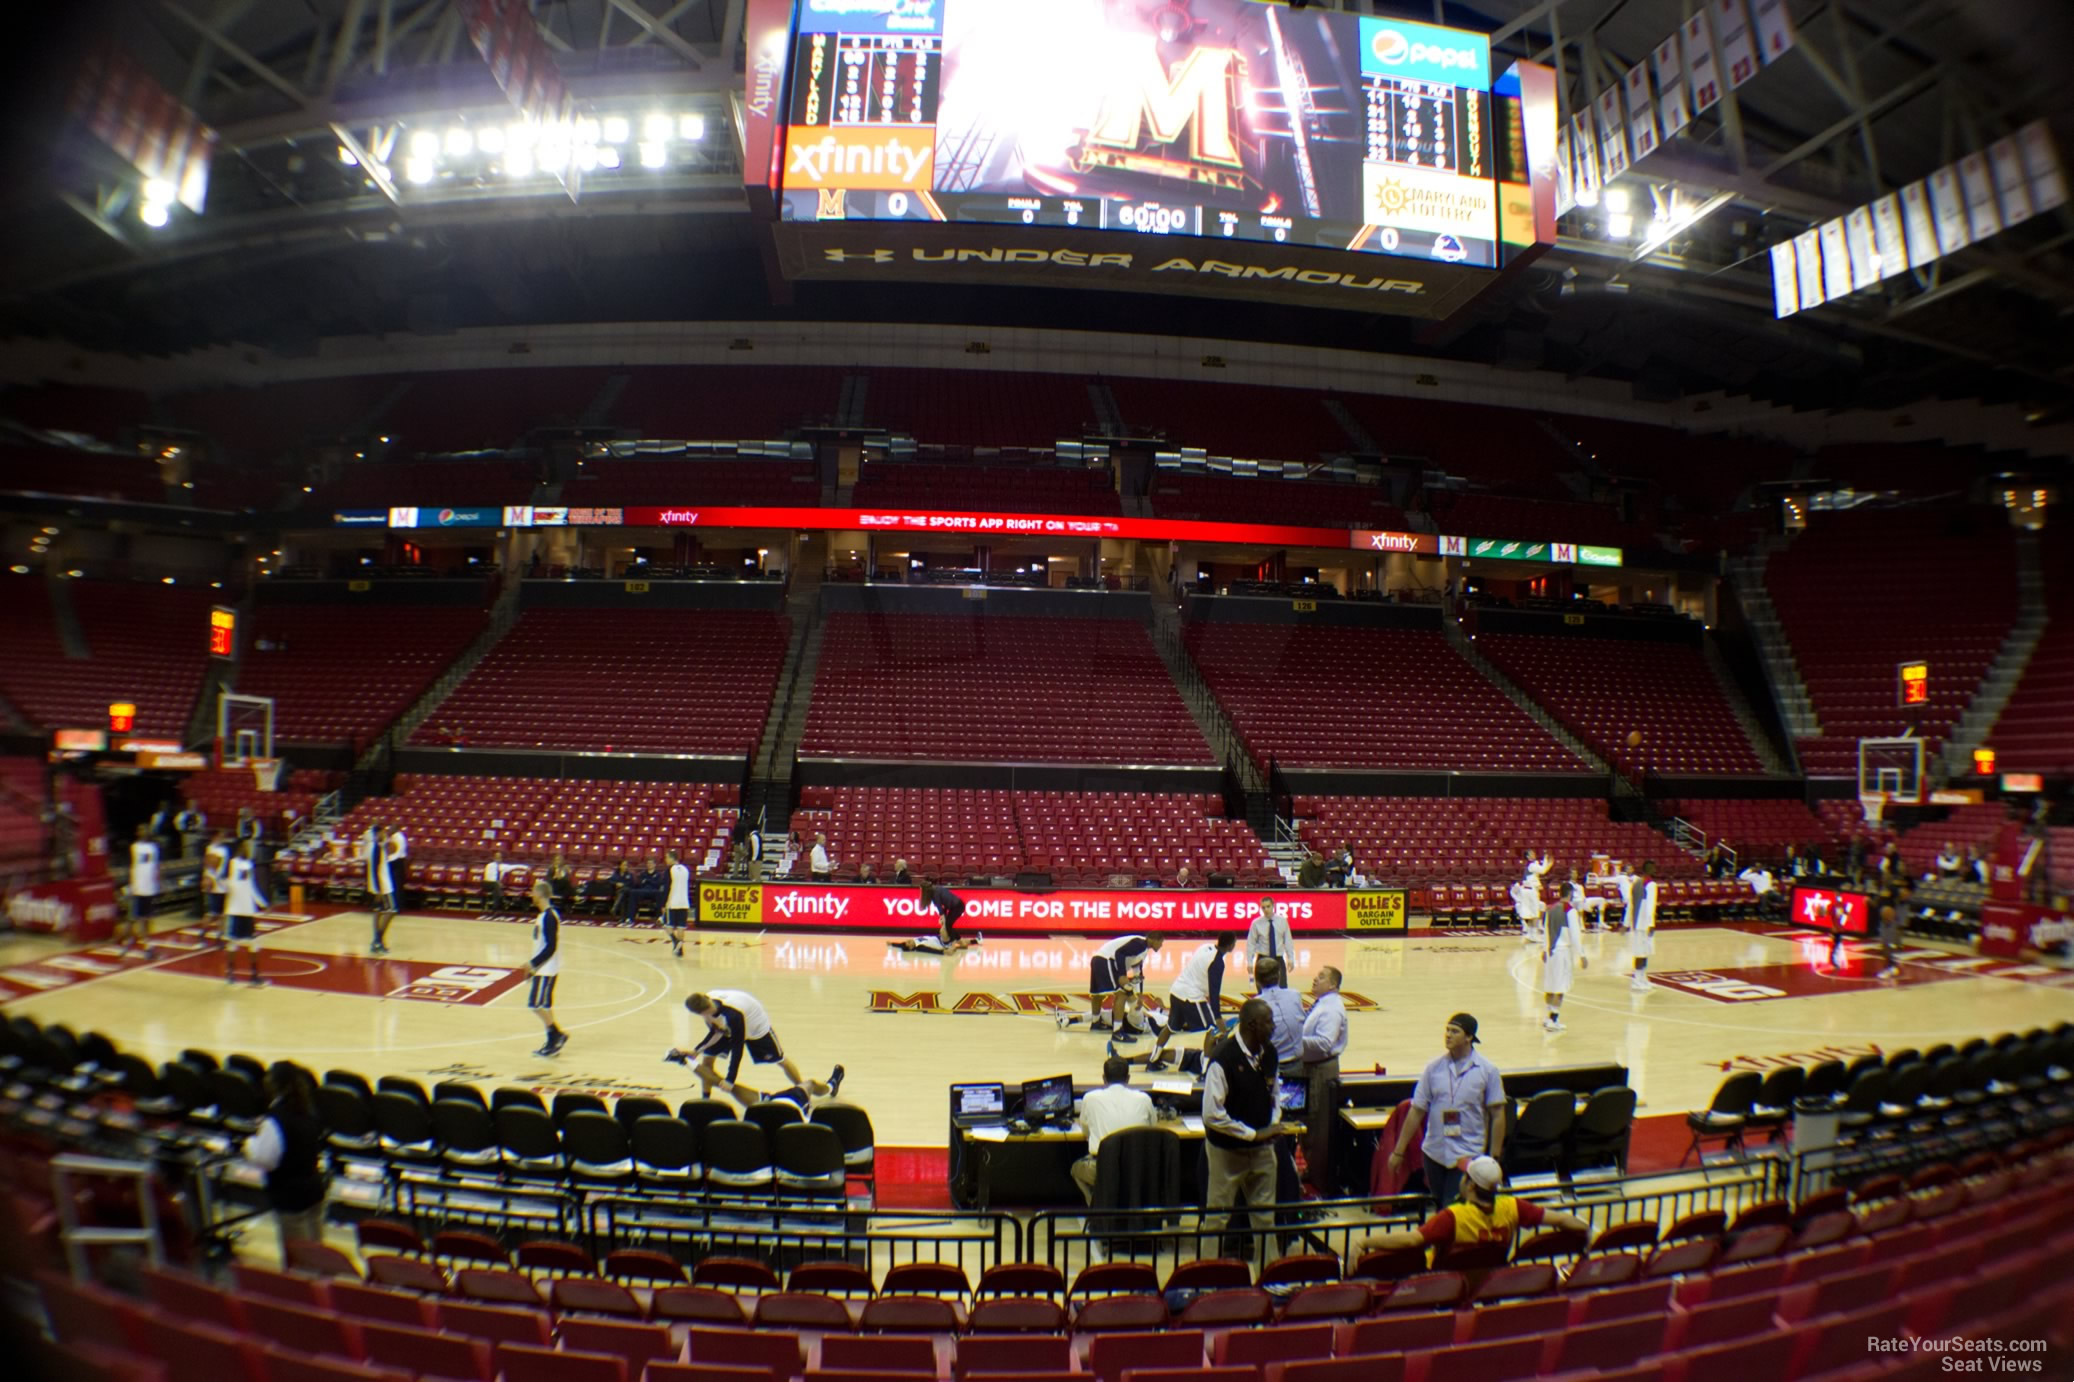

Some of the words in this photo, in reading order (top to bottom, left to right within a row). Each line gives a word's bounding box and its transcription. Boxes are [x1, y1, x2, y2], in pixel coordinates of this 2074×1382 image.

[1410, 42, 1478, 69] pepsi
[748, 55, 779, 118] xfinity
[790, 136, 932, 183] xfinity
[888, 192, 908, 216] 0
[1411, 187, 1487, 211] MARYLAND
[1023, 210, 1033, 223] 0
[1119, 206, 1185, 229] 60:00
[1411, 203, 1473, 222] LOTTERY
[1275, 228, 1286, 241] 0
[1380, 228, 1399, 251] 0
[912, 248, 1132, 268] UNDER
[1152, 257, 1423, 294] ARMOUR
[660, 511, 698, 525] xfinity
[930, 517, 976, 528] SPORTS
[979, 518, 1004, 528] APP
[1006, 519, 1043, 530] RIGHT
[1046, 520, 1064, 530] ON
[1371, 532, 1417, 551] xfinity
[711, 903, 751, 911] BARGAIN
[774, 890, 849, 919] xfinity
[962, 900, 1013, 918] OME
[1019, 901, 1064, 918] FOR
[1070, 901, 1111, 919] THE
[1117, 901, 1176, 919] MOST
[1182, 902, 1228, 919] LIVE
[1234, 902, 1313, 919] SPRTS
[1357, 910, 1394, 918] BARGAIN
[714, 911, 748, 919] OUTLET
[1360, 918, 1391, 926] OUTLET
